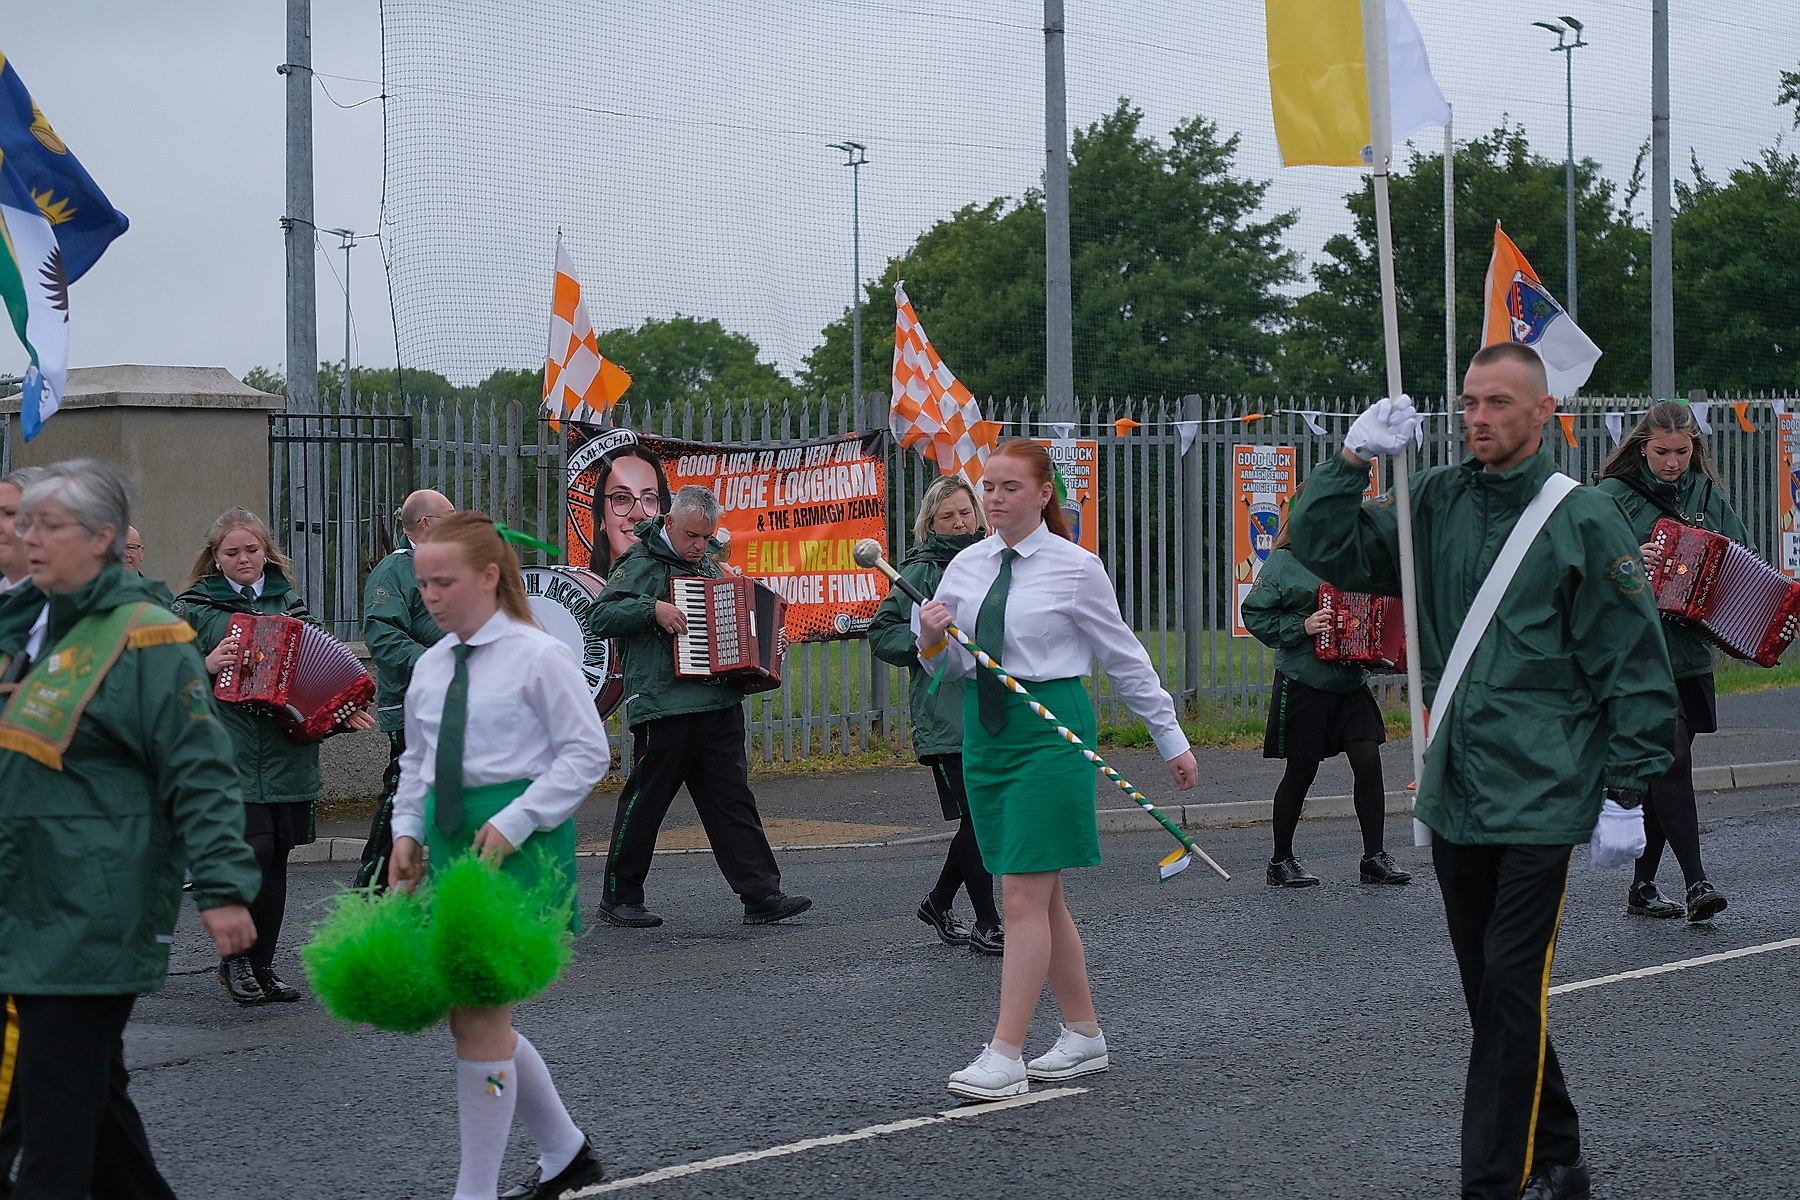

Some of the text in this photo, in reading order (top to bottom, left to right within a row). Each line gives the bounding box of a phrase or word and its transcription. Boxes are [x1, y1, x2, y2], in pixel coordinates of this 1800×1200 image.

[580, 433, 631, 464] MHACHA
[1044, 447, 1092, 461] OD LUCK
[677, 440, 863, 477] GOOD LUCK TO OUR VERY OWN
[1238, 452, 1291, 467] GOOD LUCK
[1067, 465, 1090, 476] SENIOR
[1240, 470, 1289, 480] ARMAGH SENIOR
[713, 461, 877, 512] LUCIE LOUGHRAN
[1071, 479, 1088, 489] TEAM
[1242, 482, 1287, 493] CAMOGIE TEAM
[757, 498, 880, 532] & THE ARMAGH TEAM
[748, 541, 757, 559] THE
[760, 539, 863, 572] ALL IRELAN
[757, 573, 881, 604] MOGIE FINAL
